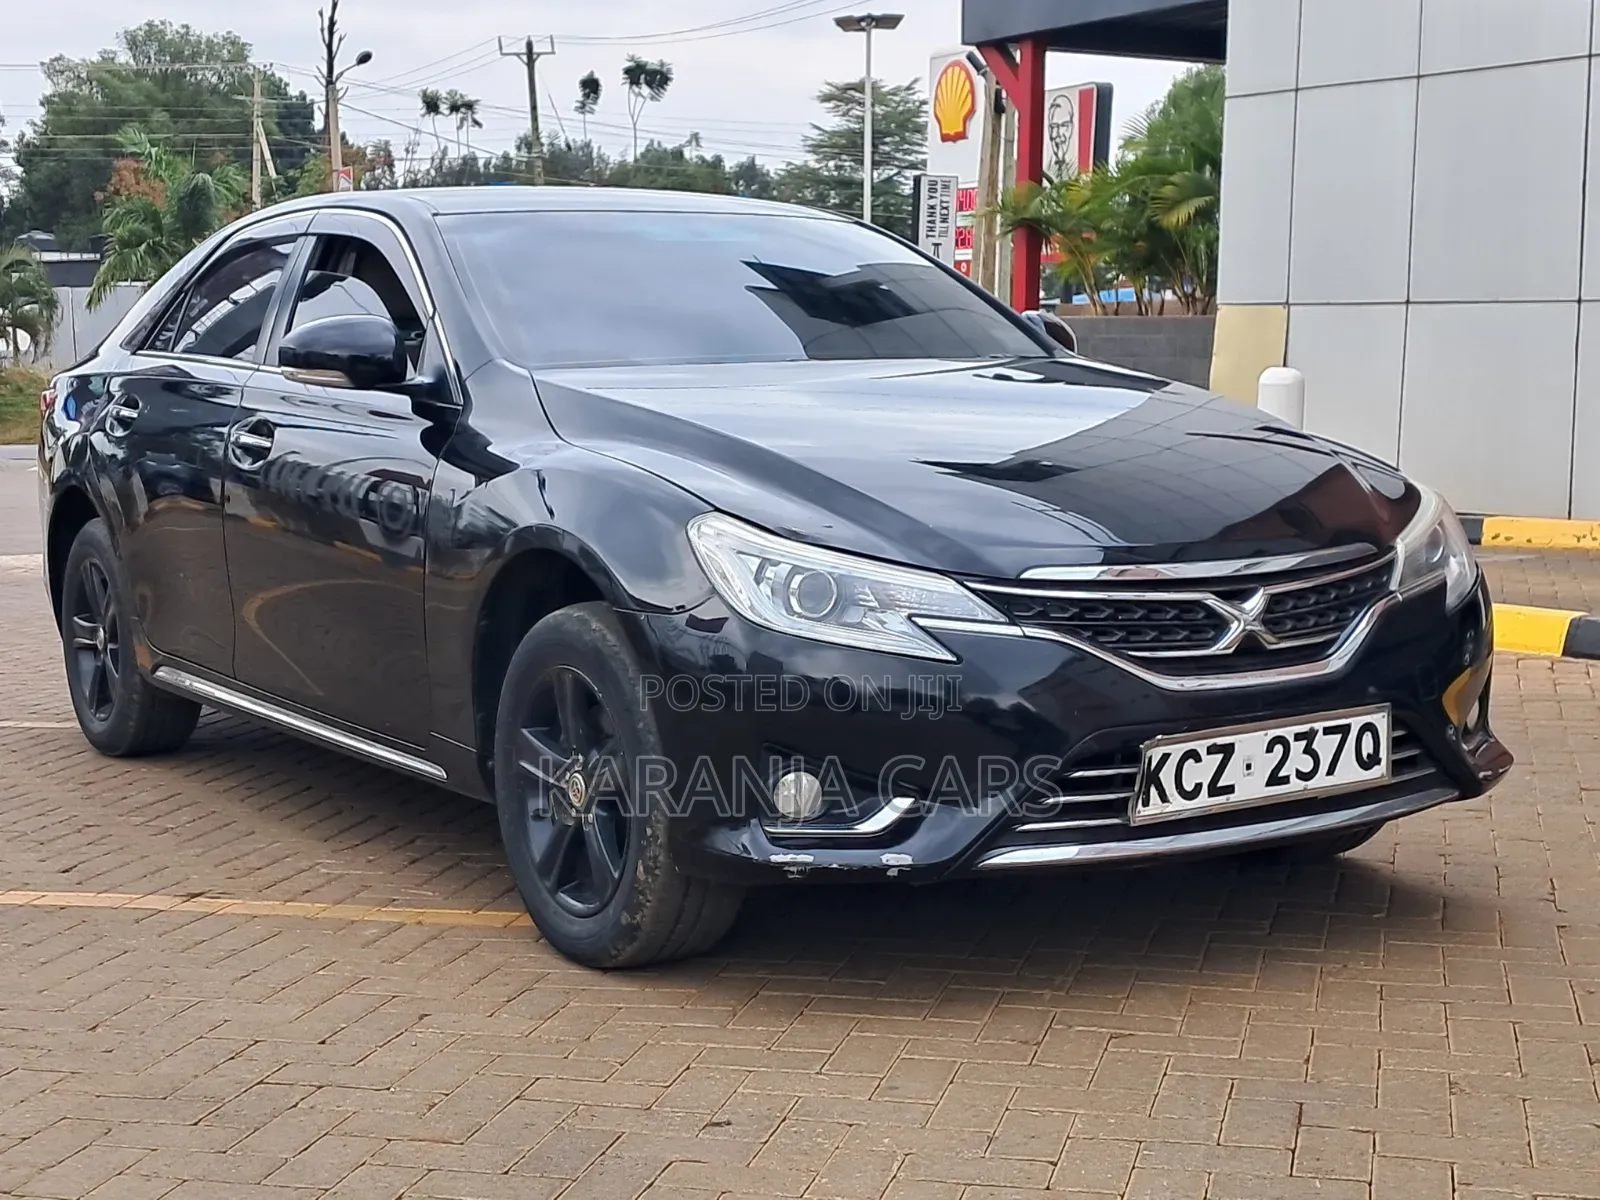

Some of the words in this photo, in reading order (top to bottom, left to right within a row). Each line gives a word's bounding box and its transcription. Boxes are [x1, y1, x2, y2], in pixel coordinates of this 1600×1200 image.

[928, 180, 938, 200] YOU
[940, 179, 951, 197] TIME
[926, 204, 938, 239] THANK
[940, 199, 950, 224] NEXT
[938, 225, 949, 237] TILL
[1141, 742, 1236, 808] KCZ
[1264, 721, 1382, 788] 237Q
